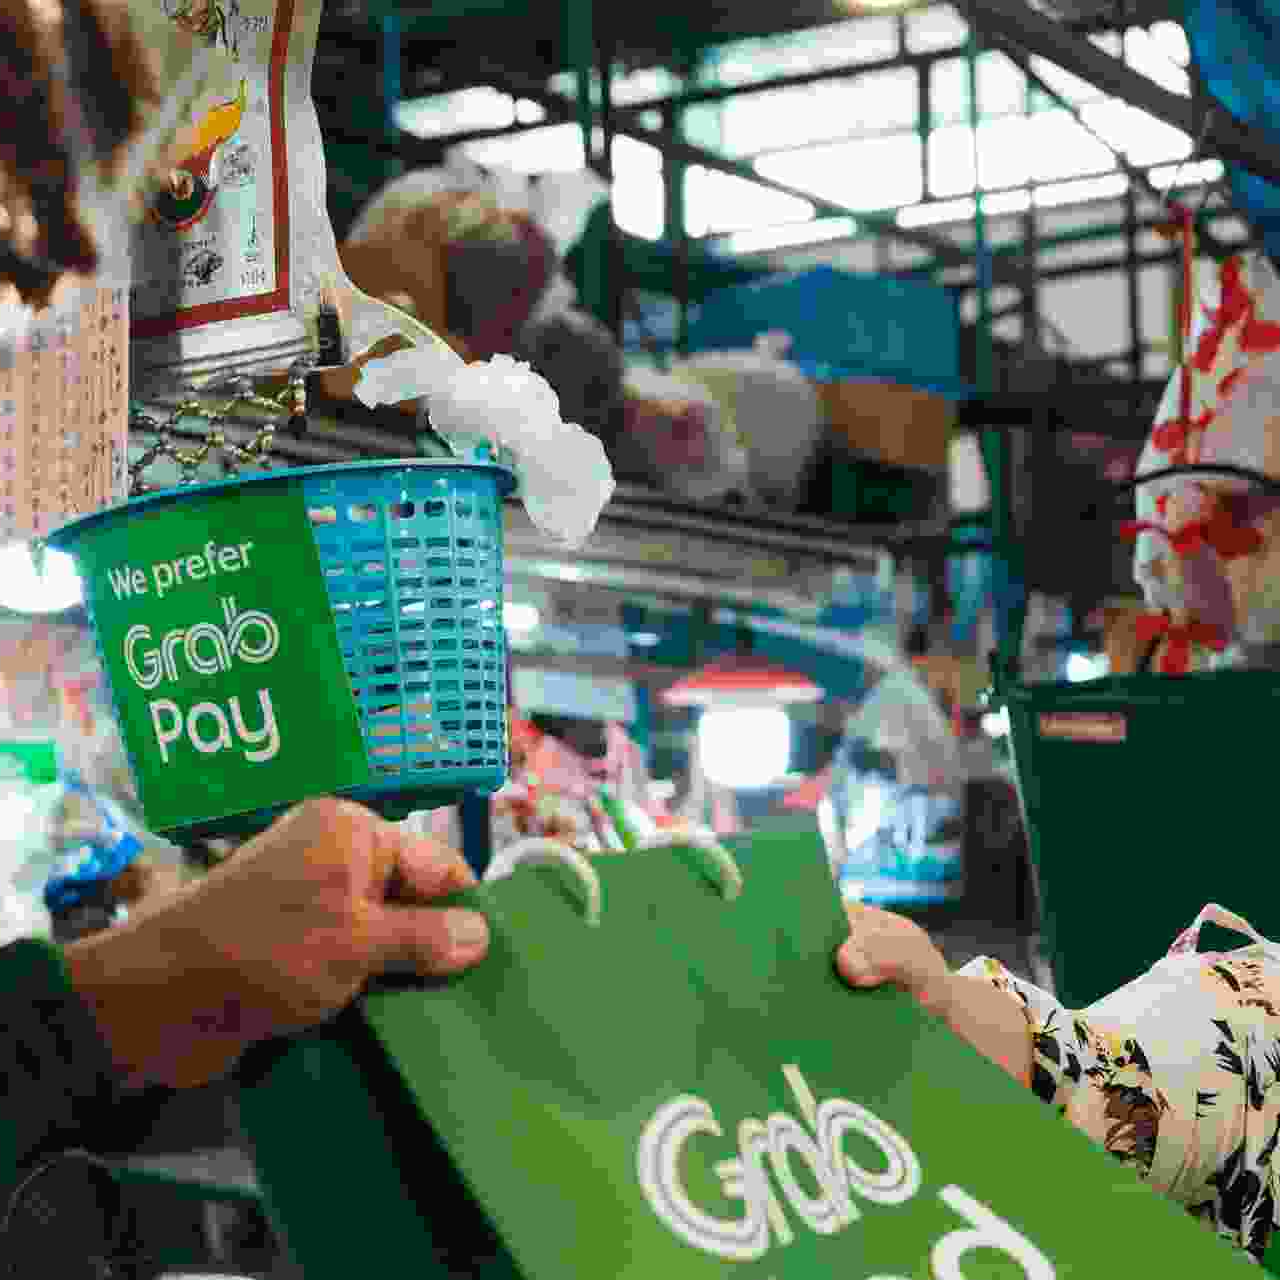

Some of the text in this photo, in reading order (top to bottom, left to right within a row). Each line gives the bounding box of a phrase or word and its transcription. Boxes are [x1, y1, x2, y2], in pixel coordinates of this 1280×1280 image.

[106, 539, 256, 600] We prefer
[123, 594, 281, 690] Grab
[149, 686, 281, 765] Pay
[635, 1062, 922, 1263] Grab
